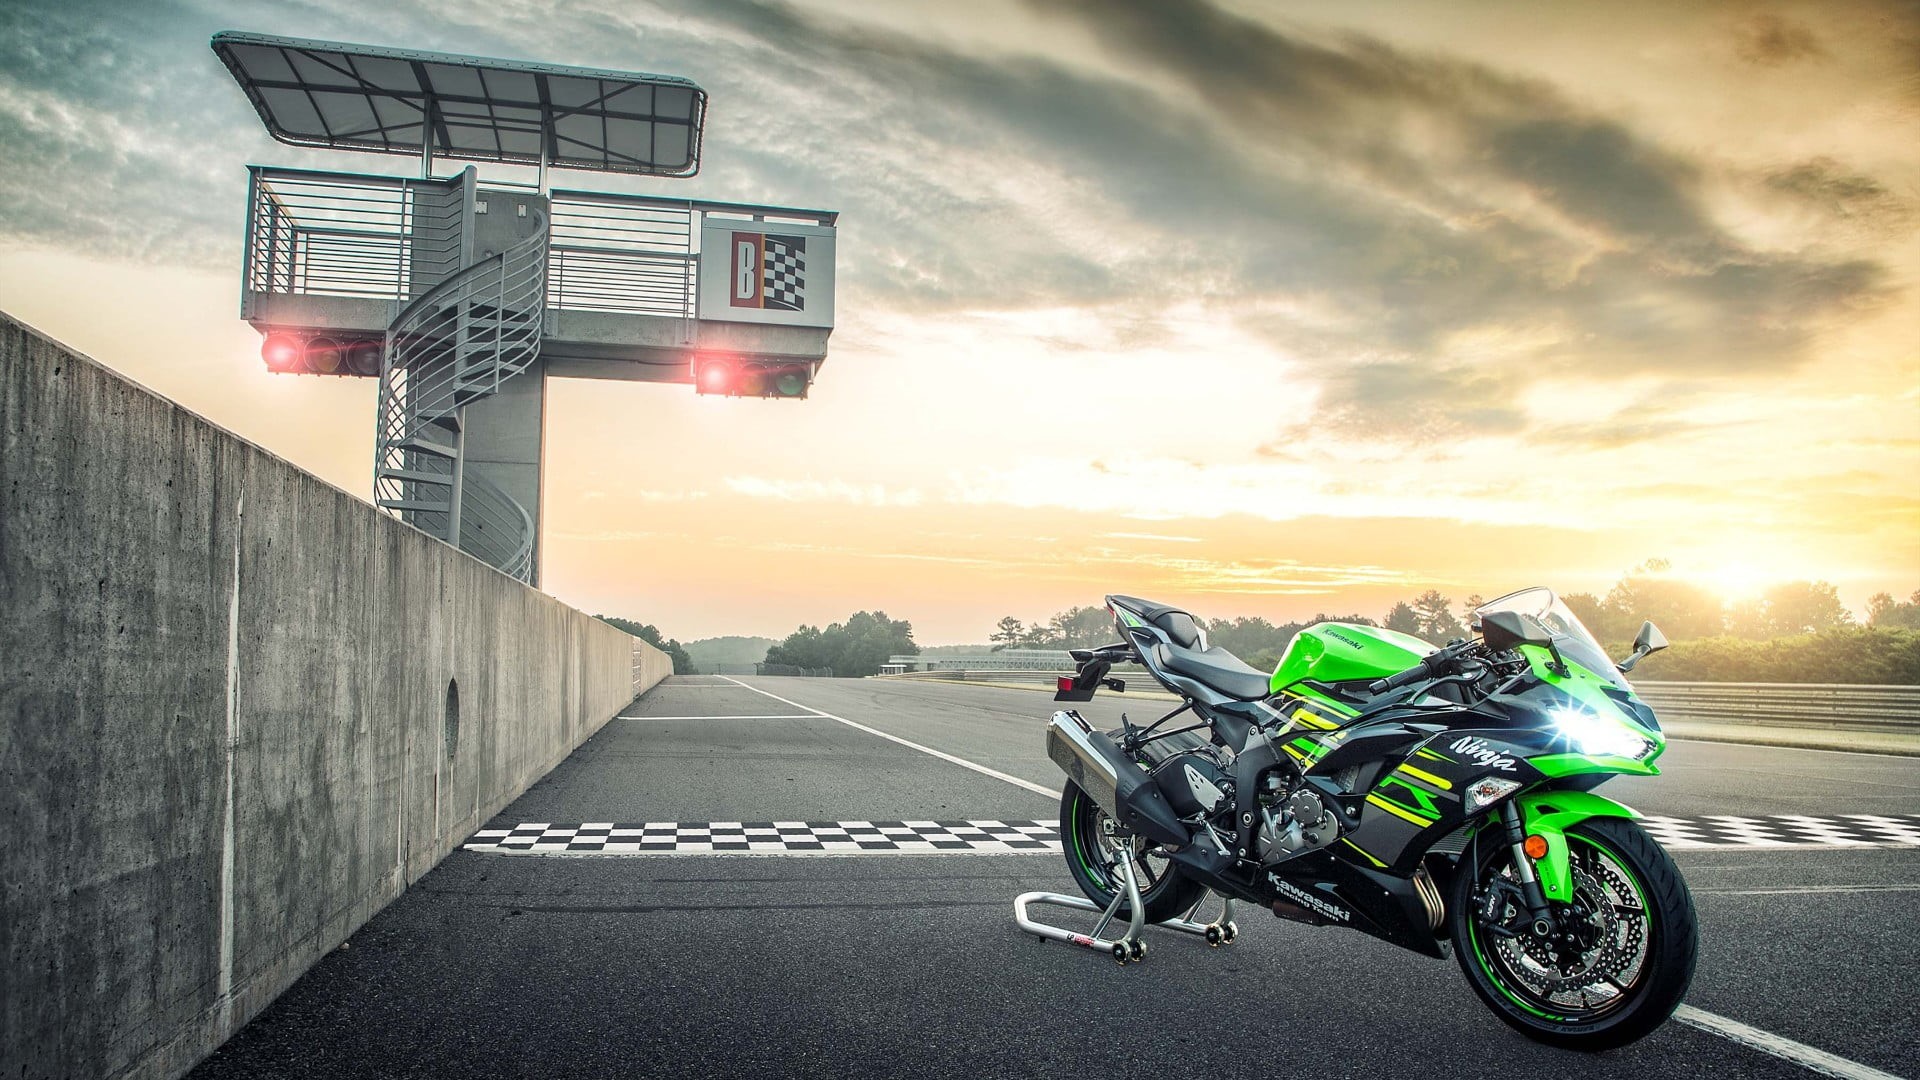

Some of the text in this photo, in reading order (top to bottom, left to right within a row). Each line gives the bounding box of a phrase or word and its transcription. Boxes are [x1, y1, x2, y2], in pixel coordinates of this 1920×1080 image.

[737, 241, 755, 299] B
[1322, 629, 1364, 650] Kawasaki
[1449, 736, 1517, 771] Ninja
[1268, 871, 1350, 922] Kawasaki
[1276, 886, 1339, 922] Racing Team
